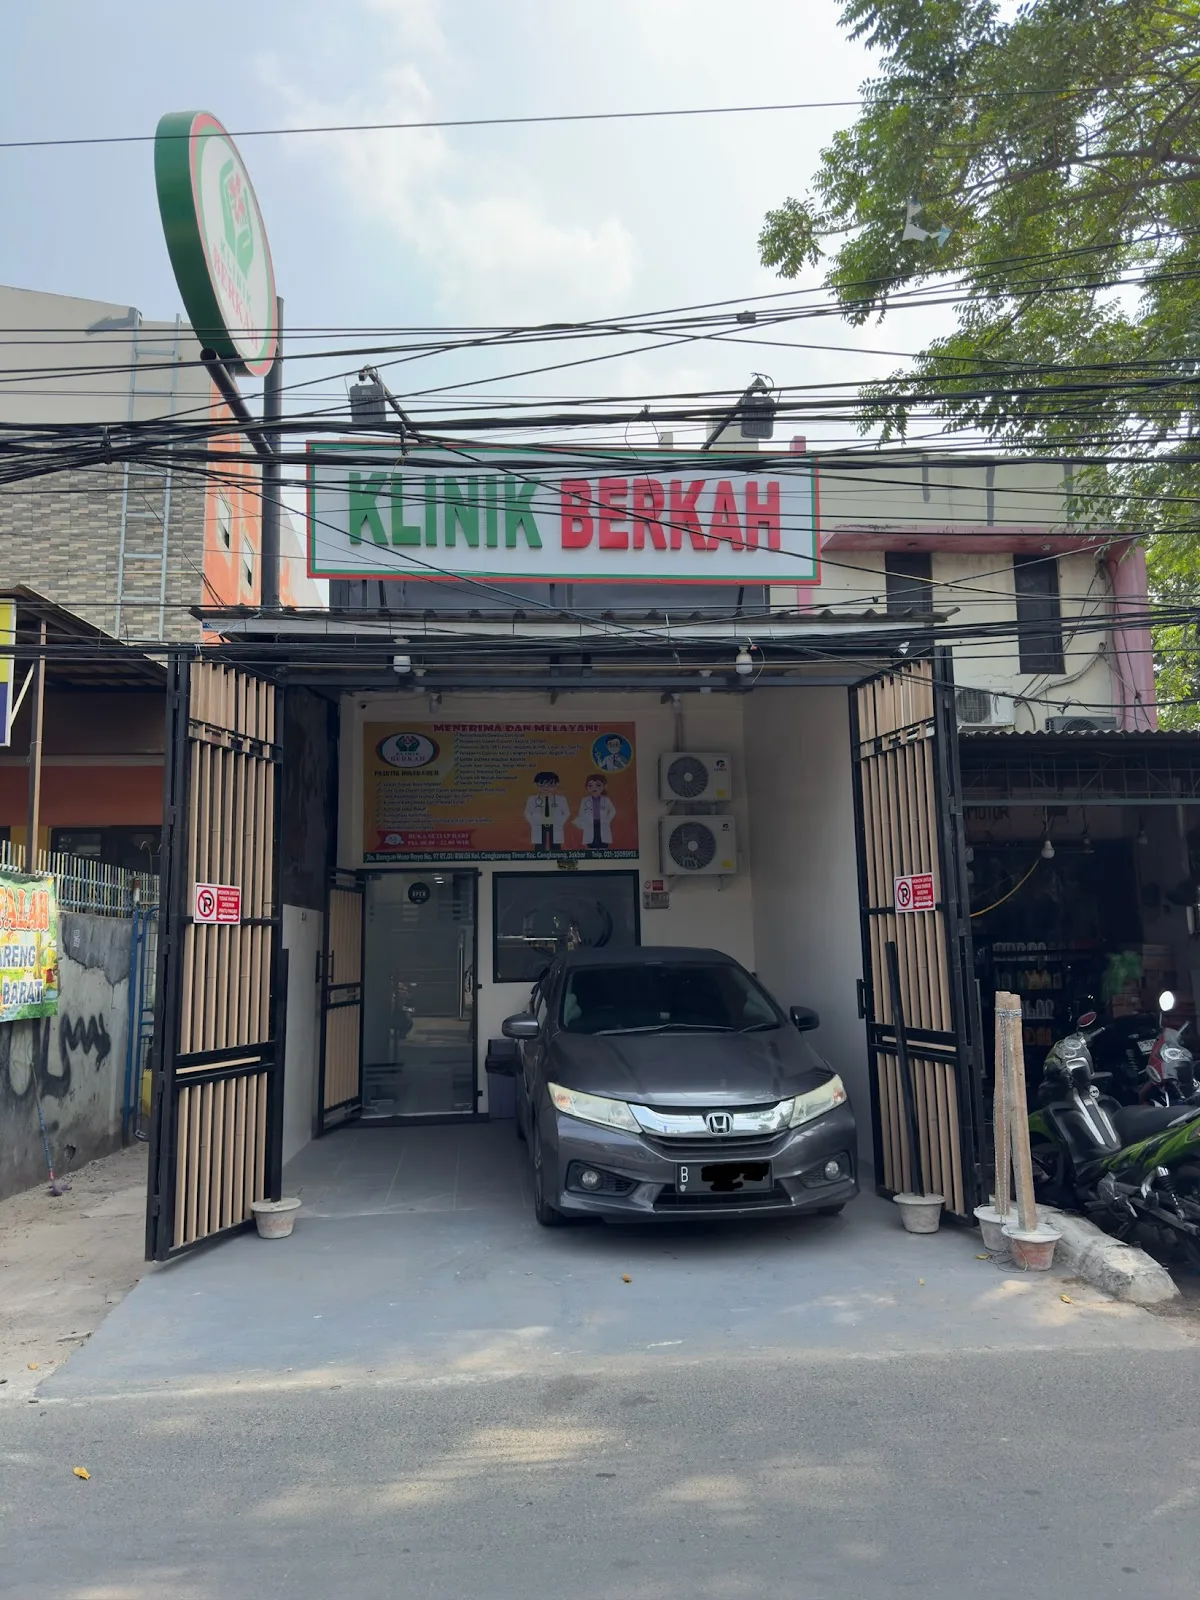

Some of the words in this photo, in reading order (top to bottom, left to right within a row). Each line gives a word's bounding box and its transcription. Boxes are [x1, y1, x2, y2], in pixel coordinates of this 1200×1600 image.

[220, 236, 253, 306] KLINIK
[212, 243, 259, 353] BERKAH
[349, 472, 543, 549] KLINIK
[560, 478, 781, 551] BERKAH
[433, 724, 502, 732] MENERIMA
[506, 724, 531, 732] DAN
[534, 724, 599, 732] MELAYANI
[2, 981, 43, 1005] BARAT
[681, 1166, 689, 1183] B
